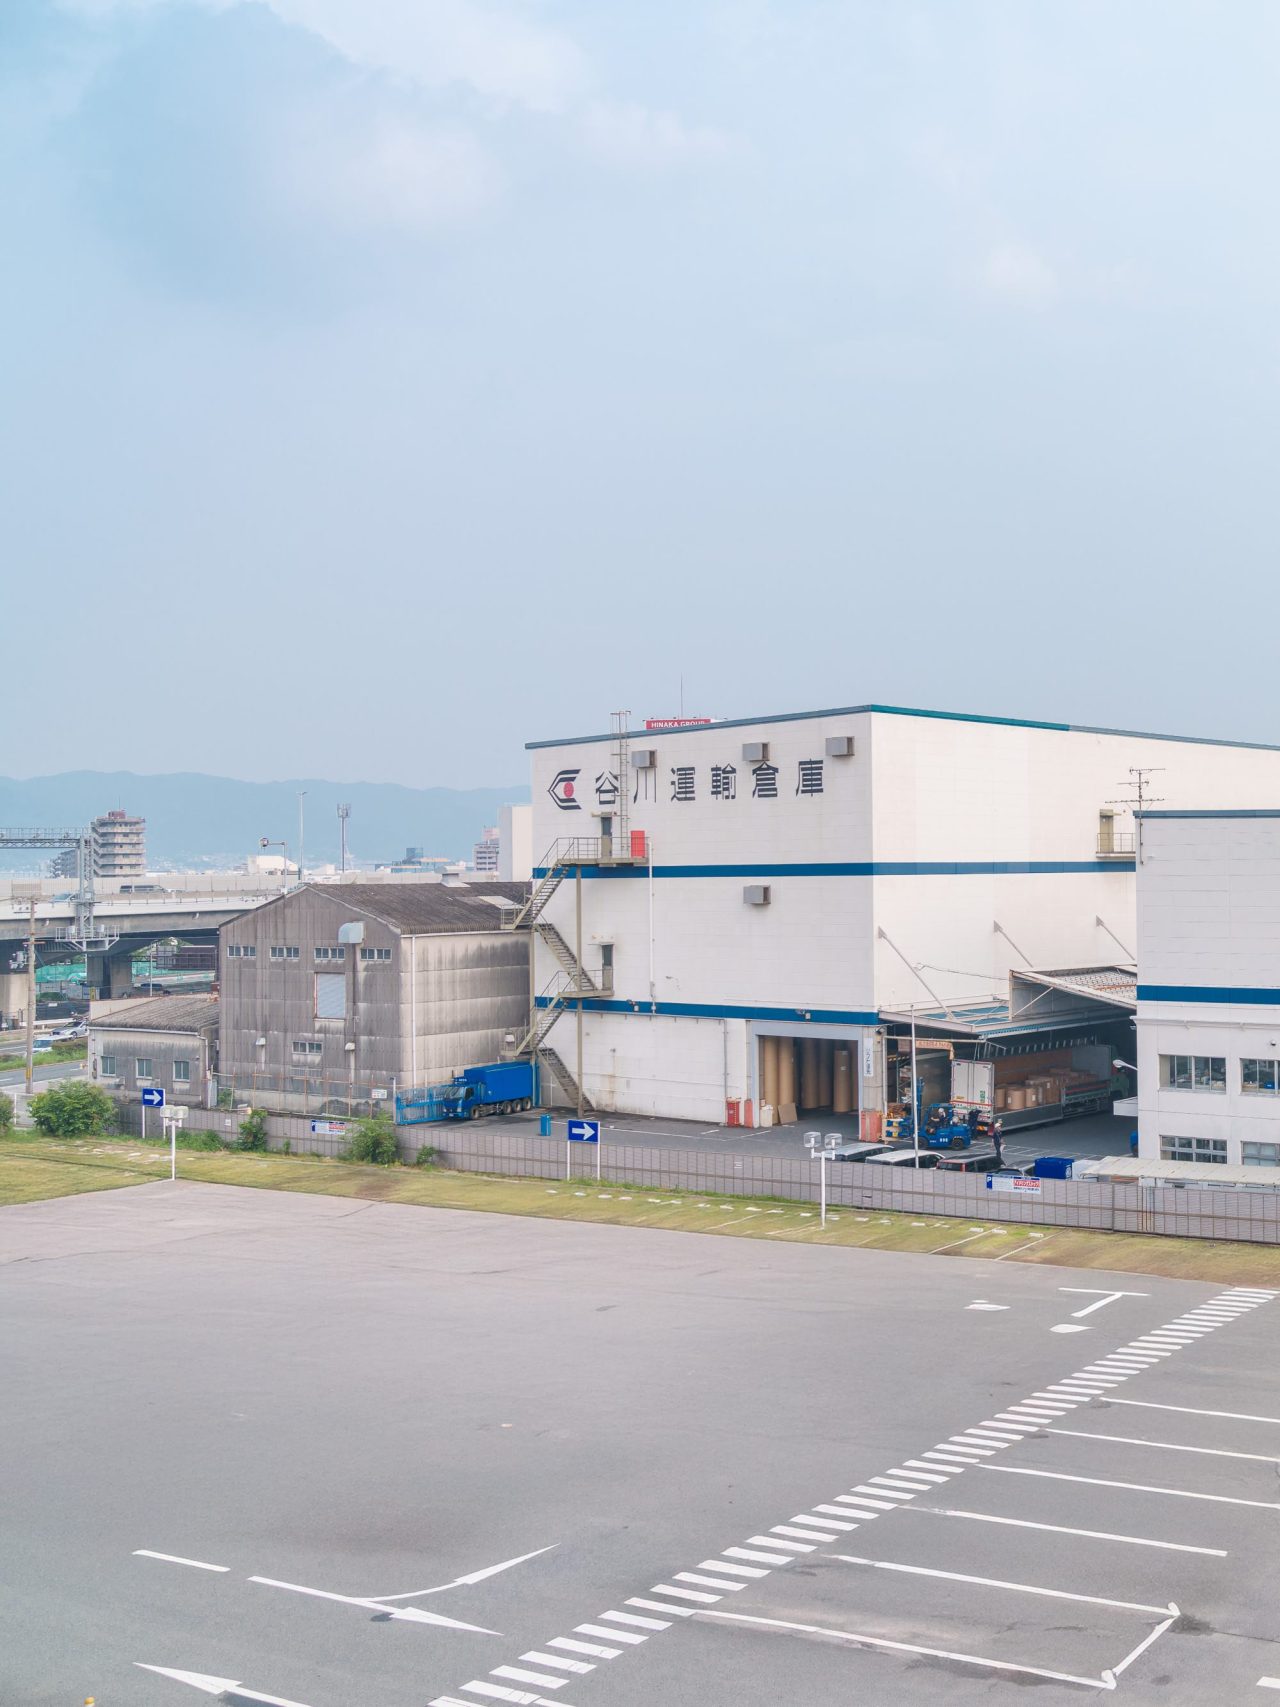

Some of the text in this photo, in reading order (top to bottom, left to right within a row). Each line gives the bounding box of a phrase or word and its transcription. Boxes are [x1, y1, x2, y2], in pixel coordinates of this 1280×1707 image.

[595, 758, 824, 805] 谷川運輸倉庫
